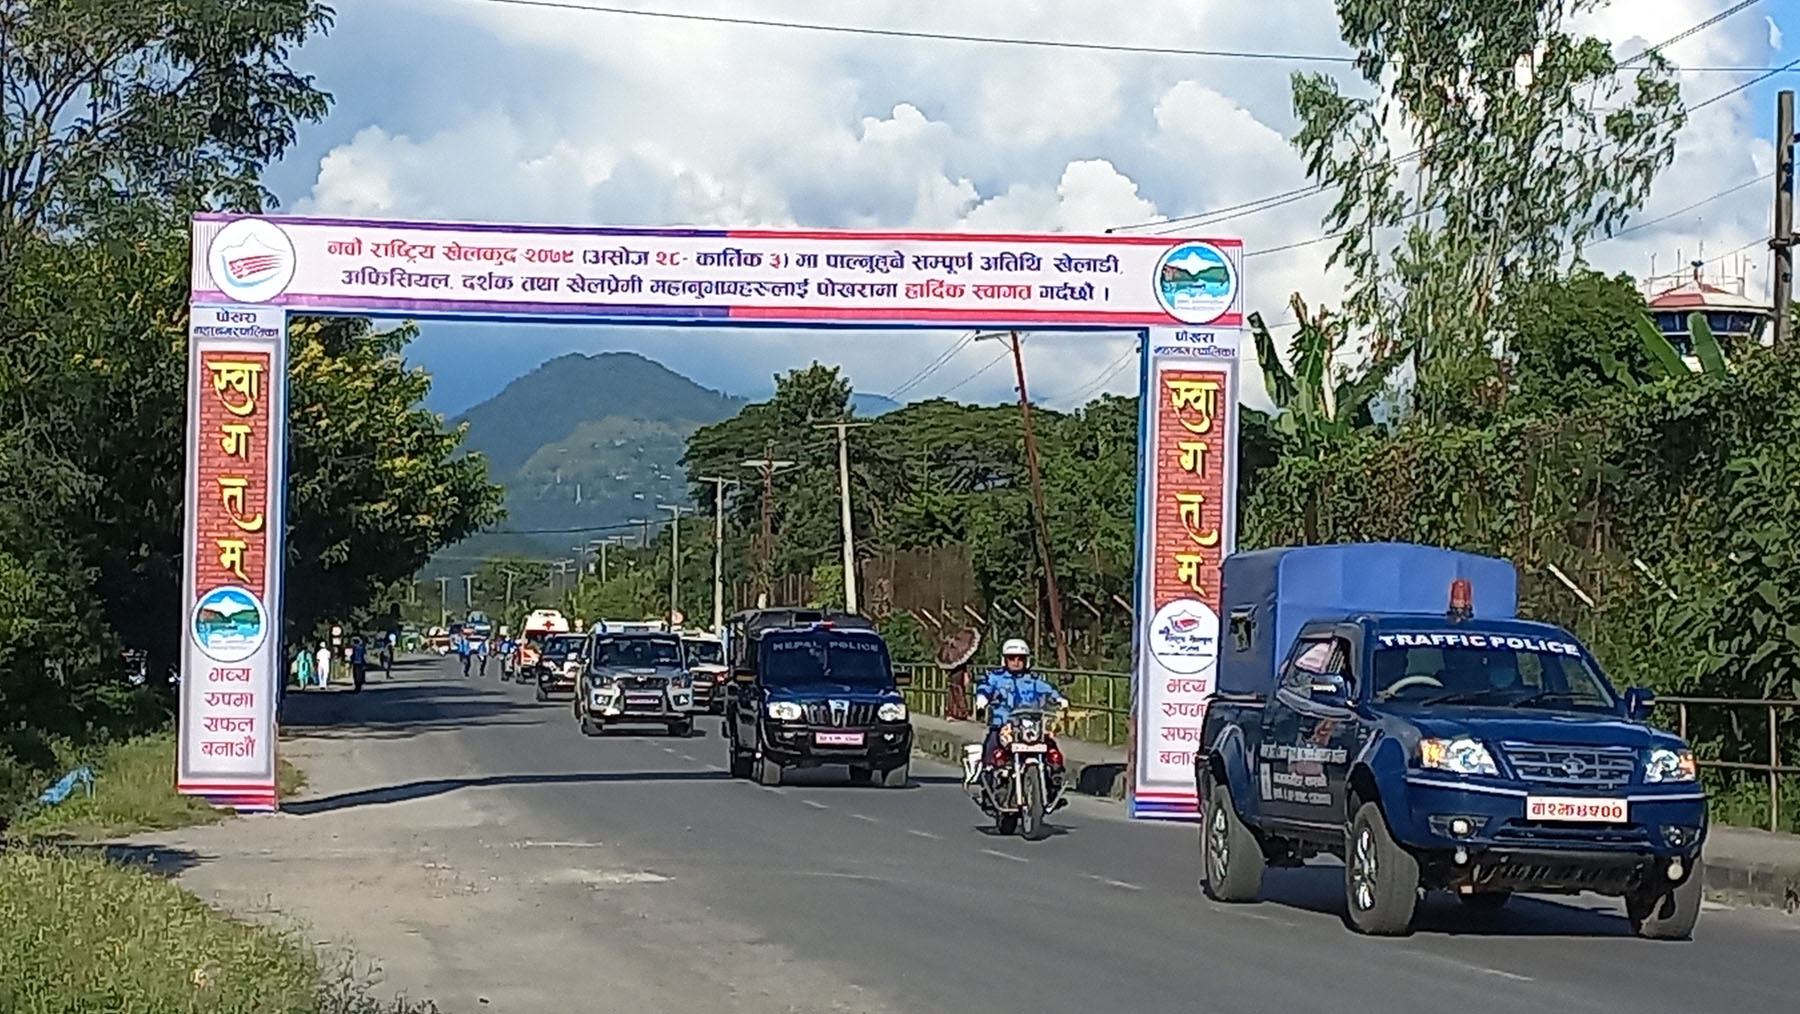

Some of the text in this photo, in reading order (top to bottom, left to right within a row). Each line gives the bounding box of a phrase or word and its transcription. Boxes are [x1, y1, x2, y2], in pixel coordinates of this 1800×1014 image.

[443, 241, 518, 266] खेलकुद
[583, 246, 649, 266] (असोज
[696, 247, 764, 268] कार्तिक
[796, 253, 819, 269] मा
[826, 250, 905, 274] पाल्नुहुने
[912, 251, 974, 275] सम्पूर्ण
[980, 251, 1042, 272] अतिथि
[462, 272, 514, 291] दर्शक
[521, 276, 560, 292] तथा
[566, 273, 643, 295] खेलप्रेमी
[817, 278, 898, 298] पोखरामा
[904, 279, 965, 300] हार्दिक
[972, 284, 1033, 301] स्वागत
[773, 640, 879, 652] NEPAL POLICE
[1379, 633, 1581, 657] TRAFFIC POLICE
[208, 667, 253, 683] भव्य
[203, 692, 255, 709] रुपमा
[203, 716, 256, 733] सफल
